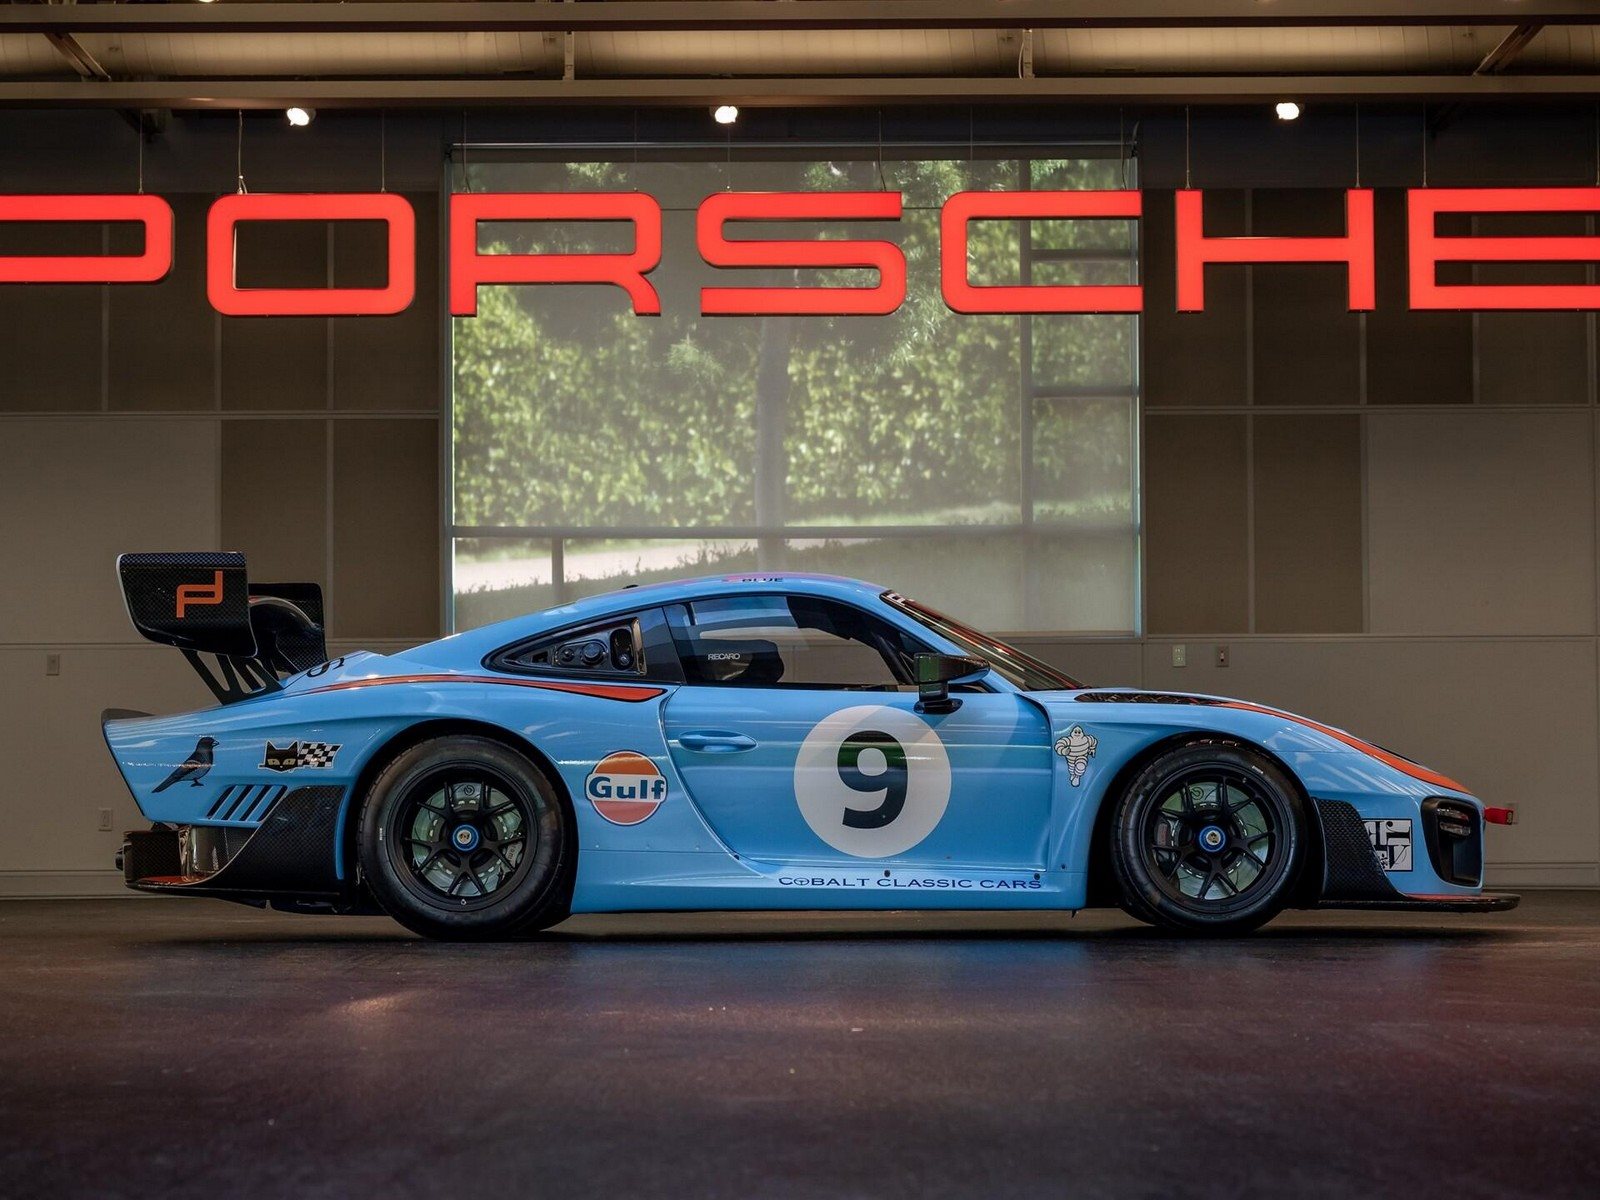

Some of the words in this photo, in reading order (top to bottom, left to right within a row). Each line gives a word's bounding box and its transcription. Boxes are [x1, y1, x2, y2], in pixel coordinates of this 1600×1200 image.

[0, 188, 1600, 316] PORSCHE
[588, 776, 665, 799] Gulf
[837, 730, 908, 829] 9
[778, 877, 870, 887] COBALT
[876, 878, 973, 889] CLASSIC
[979, 879, 1042, 890] CARS
